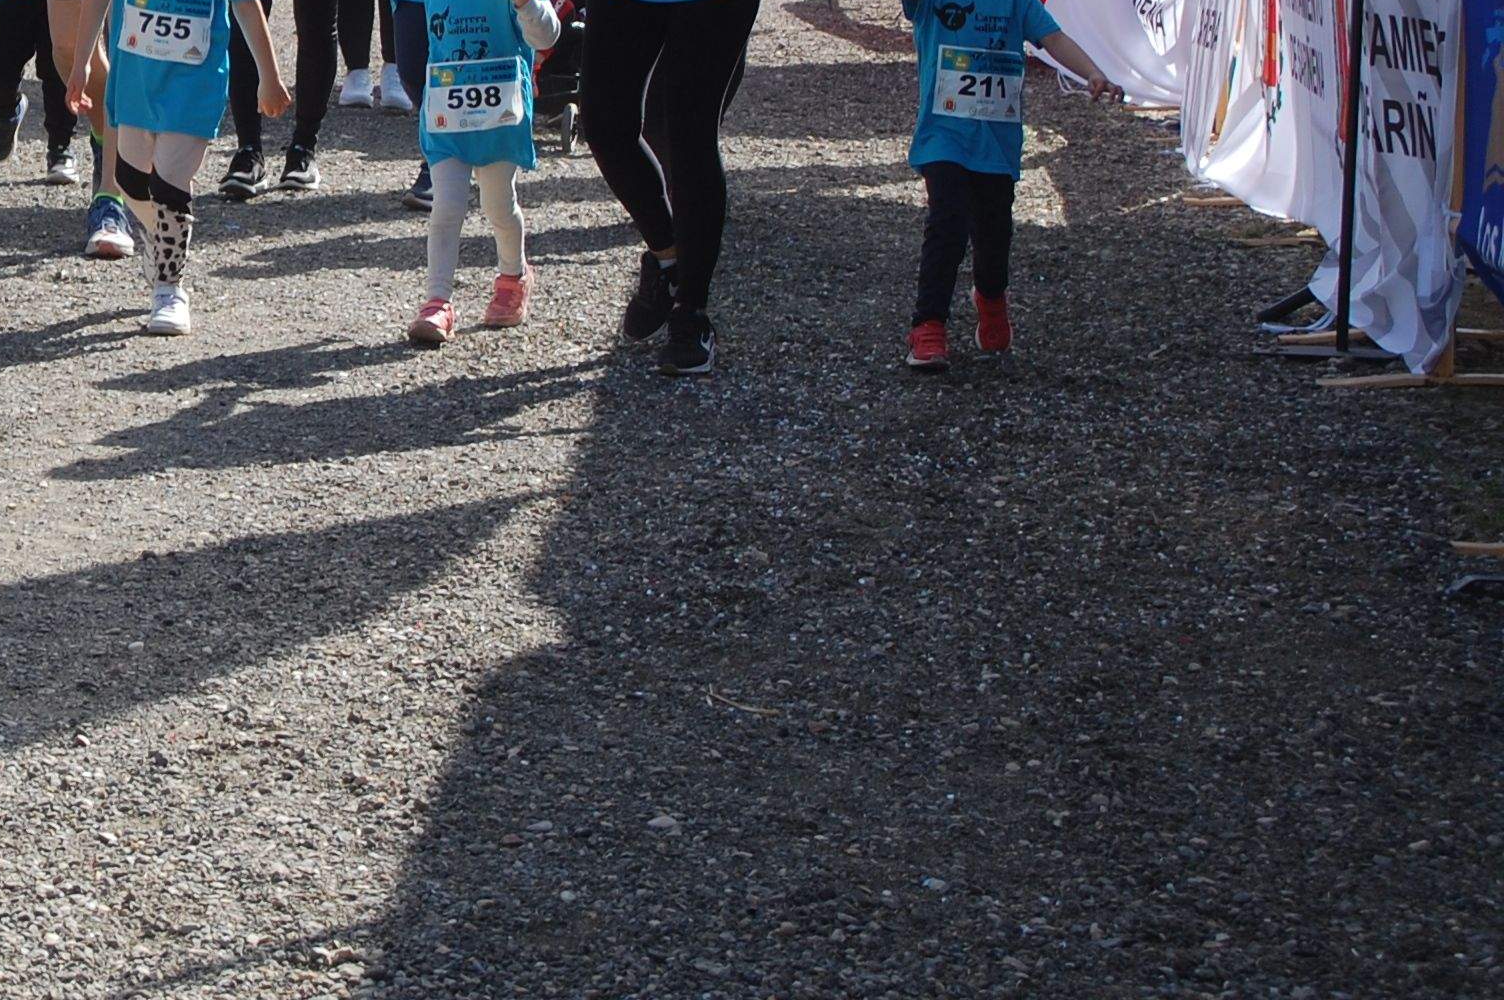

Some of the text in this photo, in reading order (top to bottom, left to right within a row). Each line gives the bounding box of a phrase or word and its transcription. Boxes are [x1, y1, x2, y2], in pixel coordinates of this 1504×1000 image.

[139, 11, 191, 39] 755
[447, 85, 502, 110] 598
[957, 74, 1006, 98] 211
